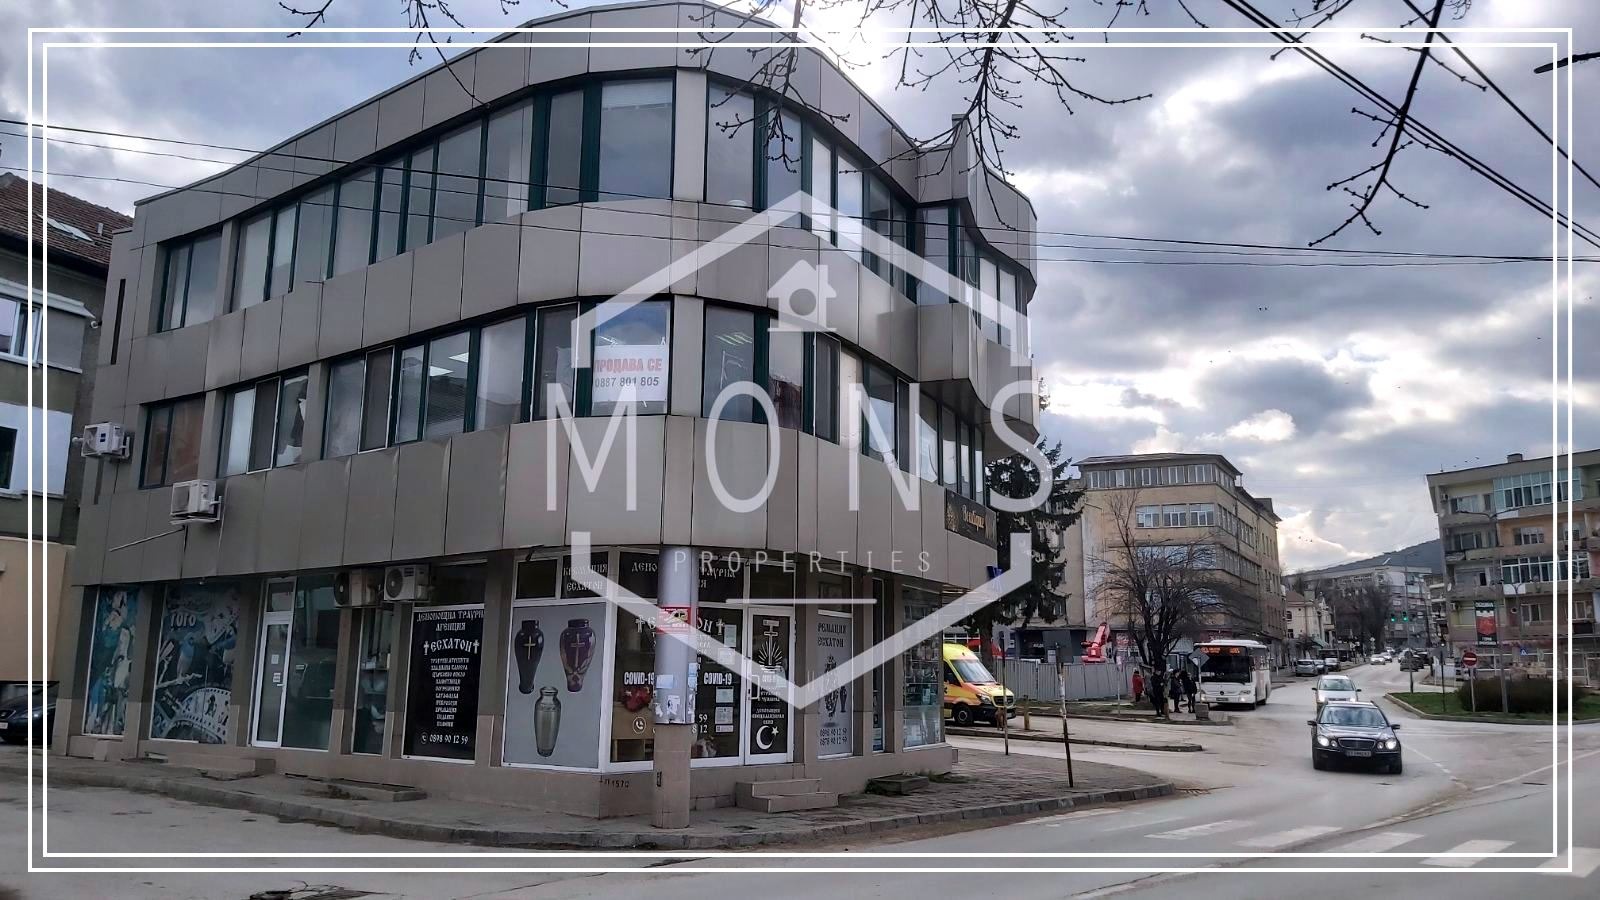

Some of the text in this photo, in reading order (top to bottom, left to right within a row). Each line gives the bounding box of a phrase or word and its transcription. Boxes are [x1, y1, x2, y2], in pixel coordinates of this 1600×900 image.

[647, 359, 663, 371] СЕ
[624, 671, 655, 685] COVID-19
[703, 672, 732, 685] COVID-19
[453, 735, 460, 744] 12
